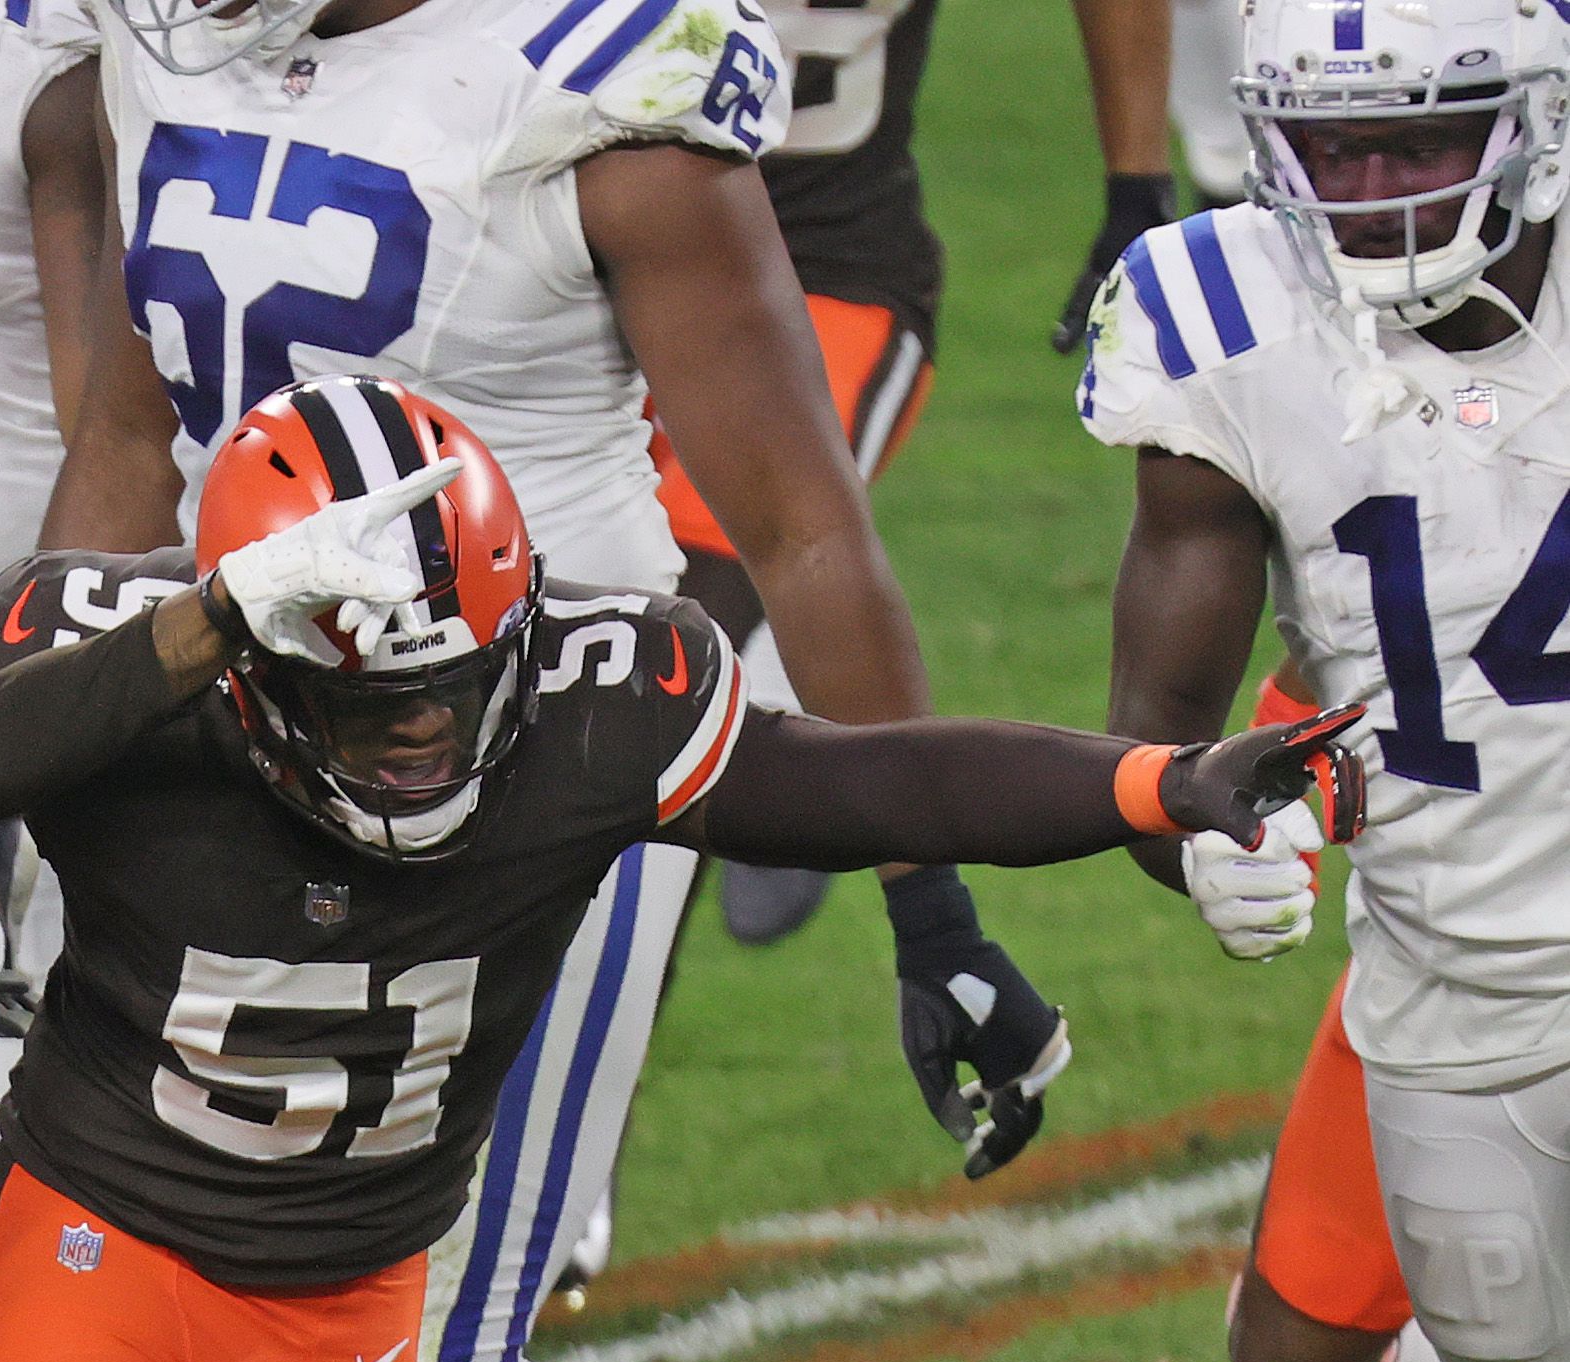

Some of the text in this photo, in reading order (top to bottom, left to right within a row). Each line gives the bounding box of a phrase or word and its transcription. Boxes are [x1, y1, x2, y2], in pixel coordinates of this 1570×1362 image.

[1324, 60, 1373, 74] COLTS
[124, 121, 432, 448] 62
[391, 630, 447, 656] BROWNS
[151, 945, 481, 1161] 51
[65, 1243, 95, 1264] NFL
